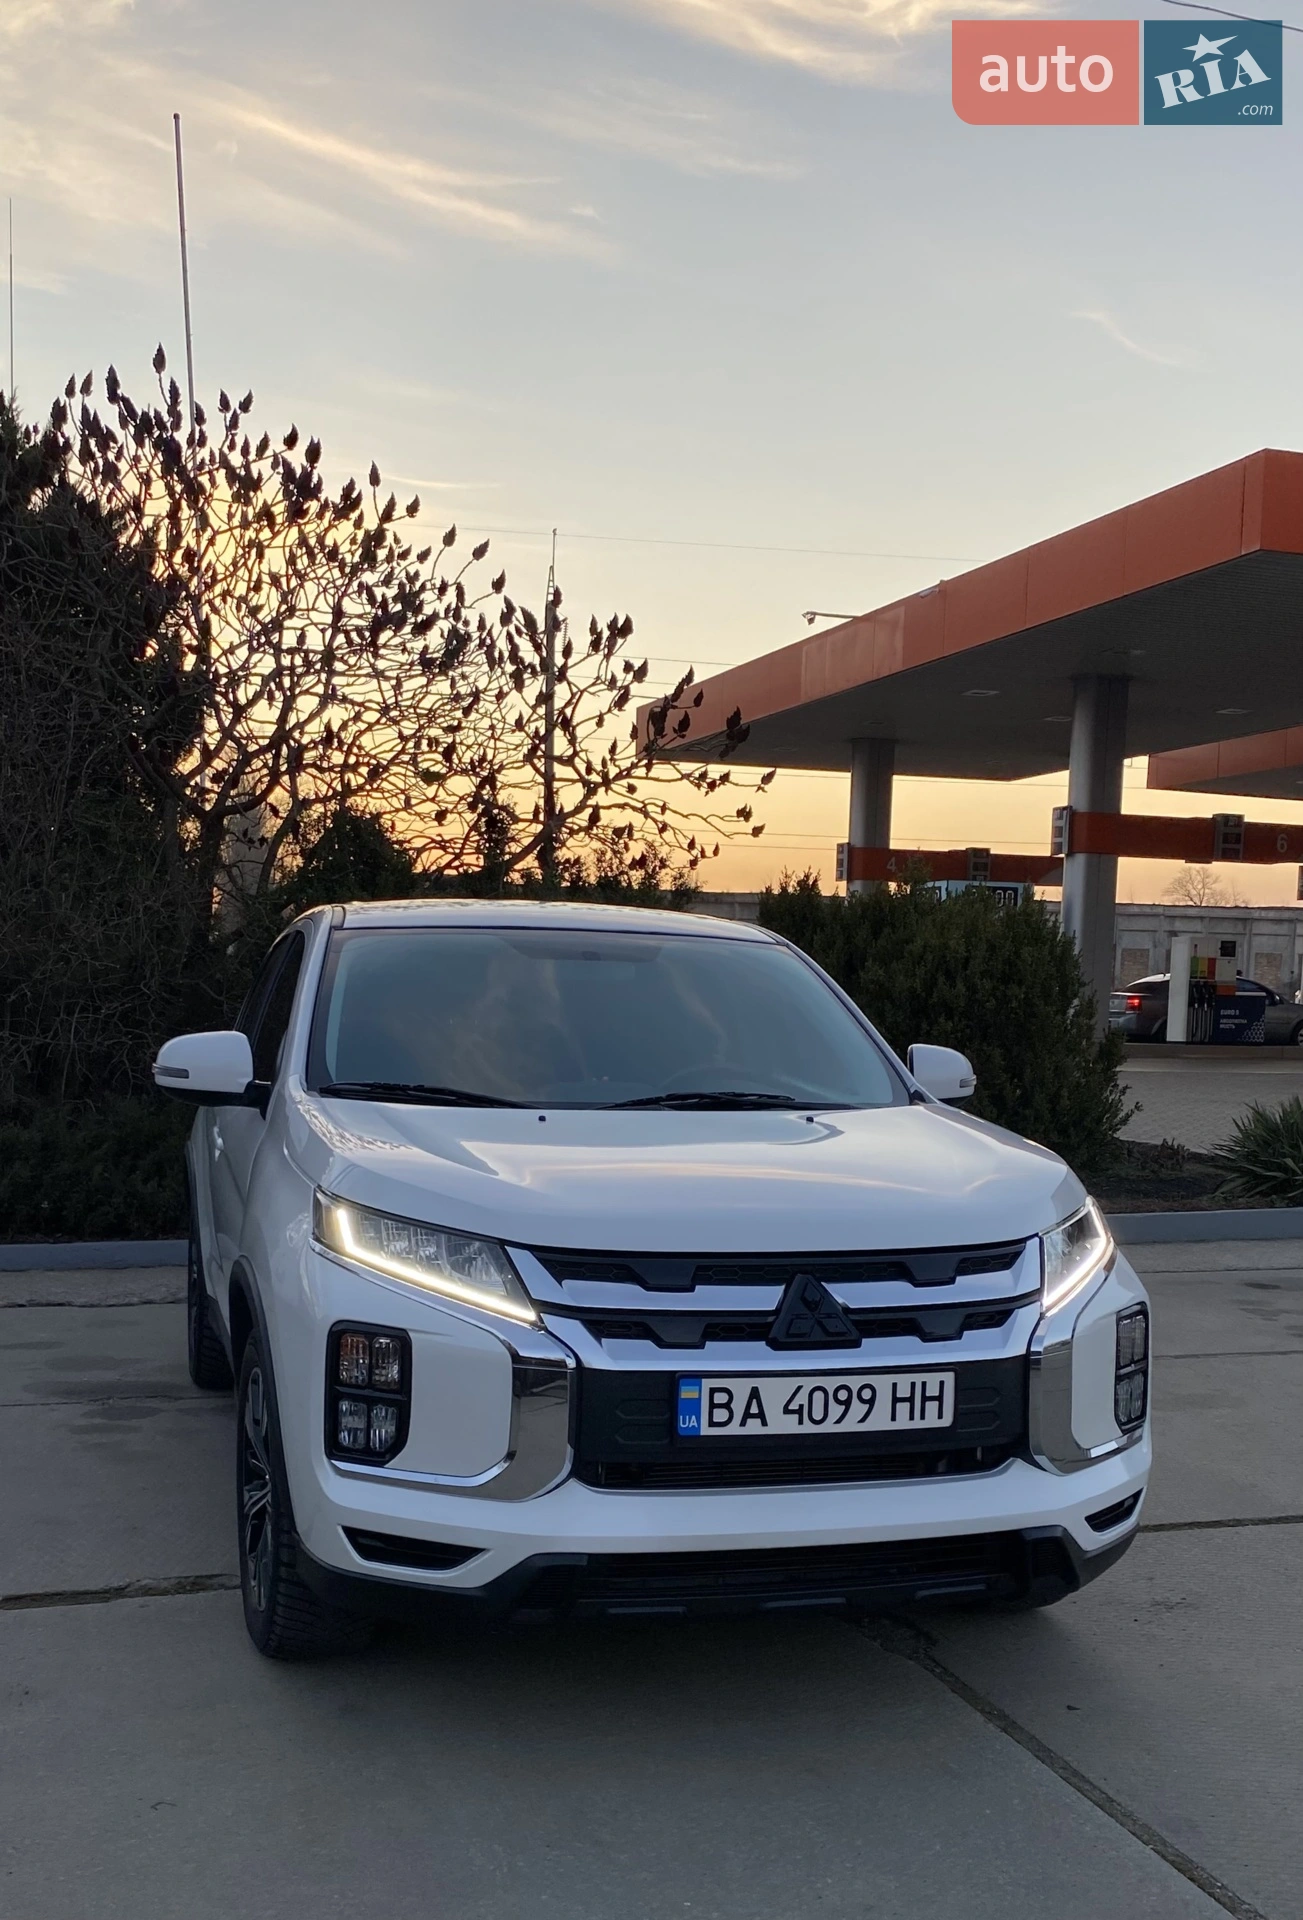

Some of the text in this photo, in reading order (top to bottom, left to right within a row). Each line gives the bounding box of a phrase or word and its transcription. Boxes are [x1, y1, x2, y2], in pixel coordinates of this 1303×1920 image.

[1276, 833, 1288, 853] 6
[886, 856, 897, 873] 4
[707, 1380, 945, 1428] BA 4099 HH
[679, 1415, 698, 1428] UA
